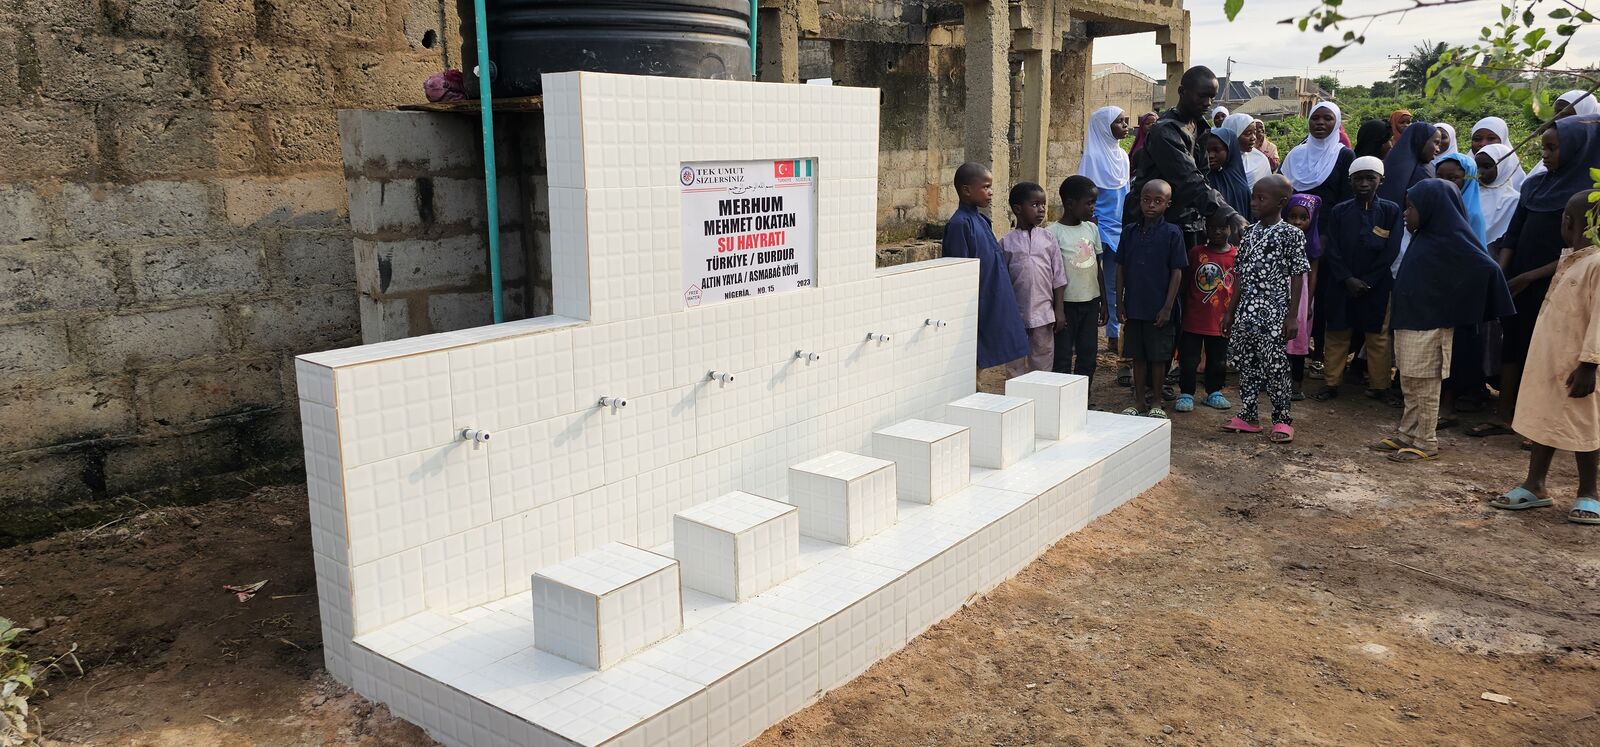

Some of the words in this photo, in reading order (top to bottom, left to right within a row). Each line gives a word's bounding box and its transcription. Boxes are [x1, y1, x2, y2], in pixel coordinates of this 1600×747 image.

[696, 175, 744, 184] SİZLERSİNİZ
[719, 196, 783, 216] MERHUM
[704, 217, 752, 236] MEHMET
[755, 213, 796, 230] OKATAN
[717, 236, 734, 253] SU
[738, 231, 785, 250] HAYRATI
[706, 253, 748, 271] TÜRKİYE
[750, 253, 755, 265] /
[758, 248, 794, 264] BURDUR
[701, 276, 721, 289] ALTIN
[723, 274, 742, 286] YAYLA
[749, 265, 781, 282] ASMABAĞ
[782, 263, 799, 277] KÖYÜ
[768, 285, 774, 293] 15
[797, 279, 810, 287] 2023
